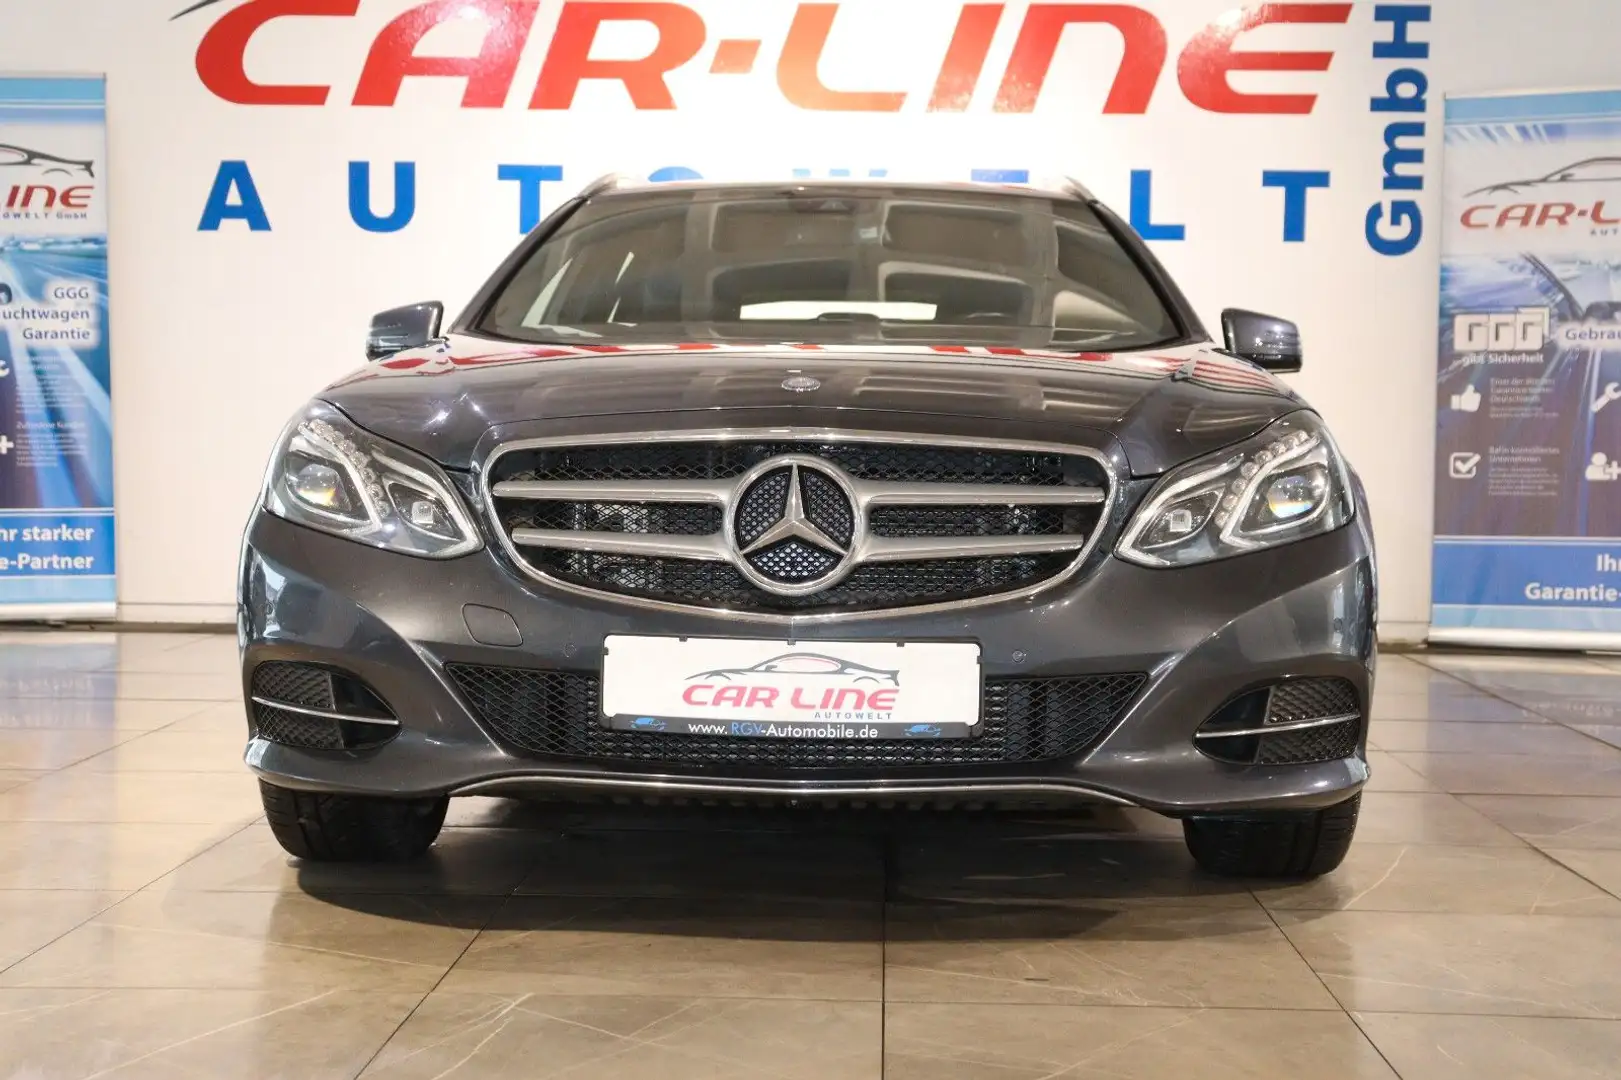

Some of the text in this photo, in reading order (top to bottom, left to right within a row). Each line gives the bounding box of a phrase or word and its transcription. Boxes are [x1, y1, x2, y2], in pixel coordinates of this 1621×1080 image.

[1365, 4, 1432, 257] GmbH
[197, 160, 1331, 243] AUTLT
[1460, 201, 1621, 229] CAR-L
[54, 287, 89, 299] GGG
[2, 306, 90, 322] uchtwagen
[23, 327, 90, 340] Garantie
[22, 524, 95, 541] starker
[0, 553, 95, 570] e-Partner
[682, 684, 900, 711] CAR LINE
[814, 711, 892, 720] AUTOWELT
